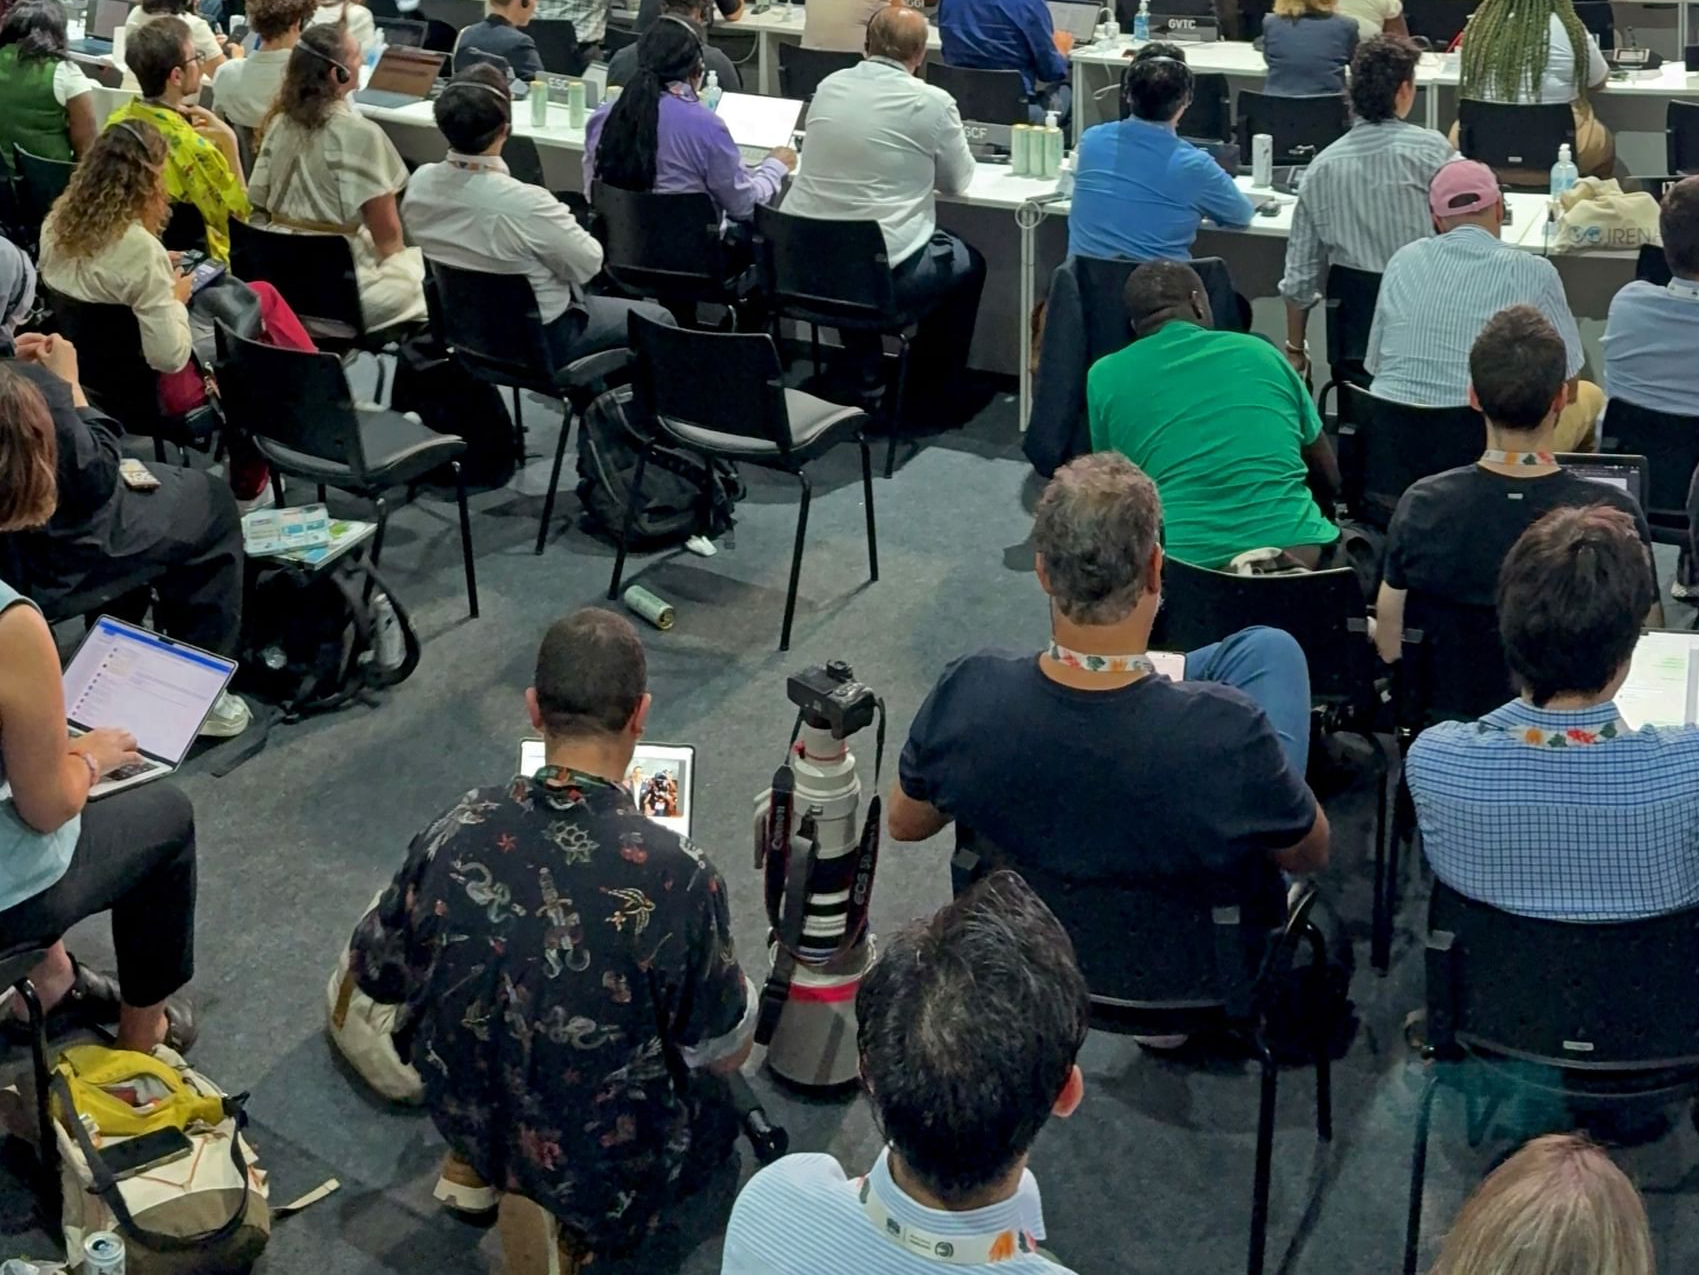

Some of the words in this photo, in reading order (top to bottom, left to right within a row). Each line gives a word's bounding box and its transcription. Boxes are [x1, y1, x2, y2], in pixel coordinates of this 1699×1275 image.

[1168, 18, 1196, 30] GVTC
[771, 805, 785, 850] Canon
[854, 872, 870, 905] EOS
